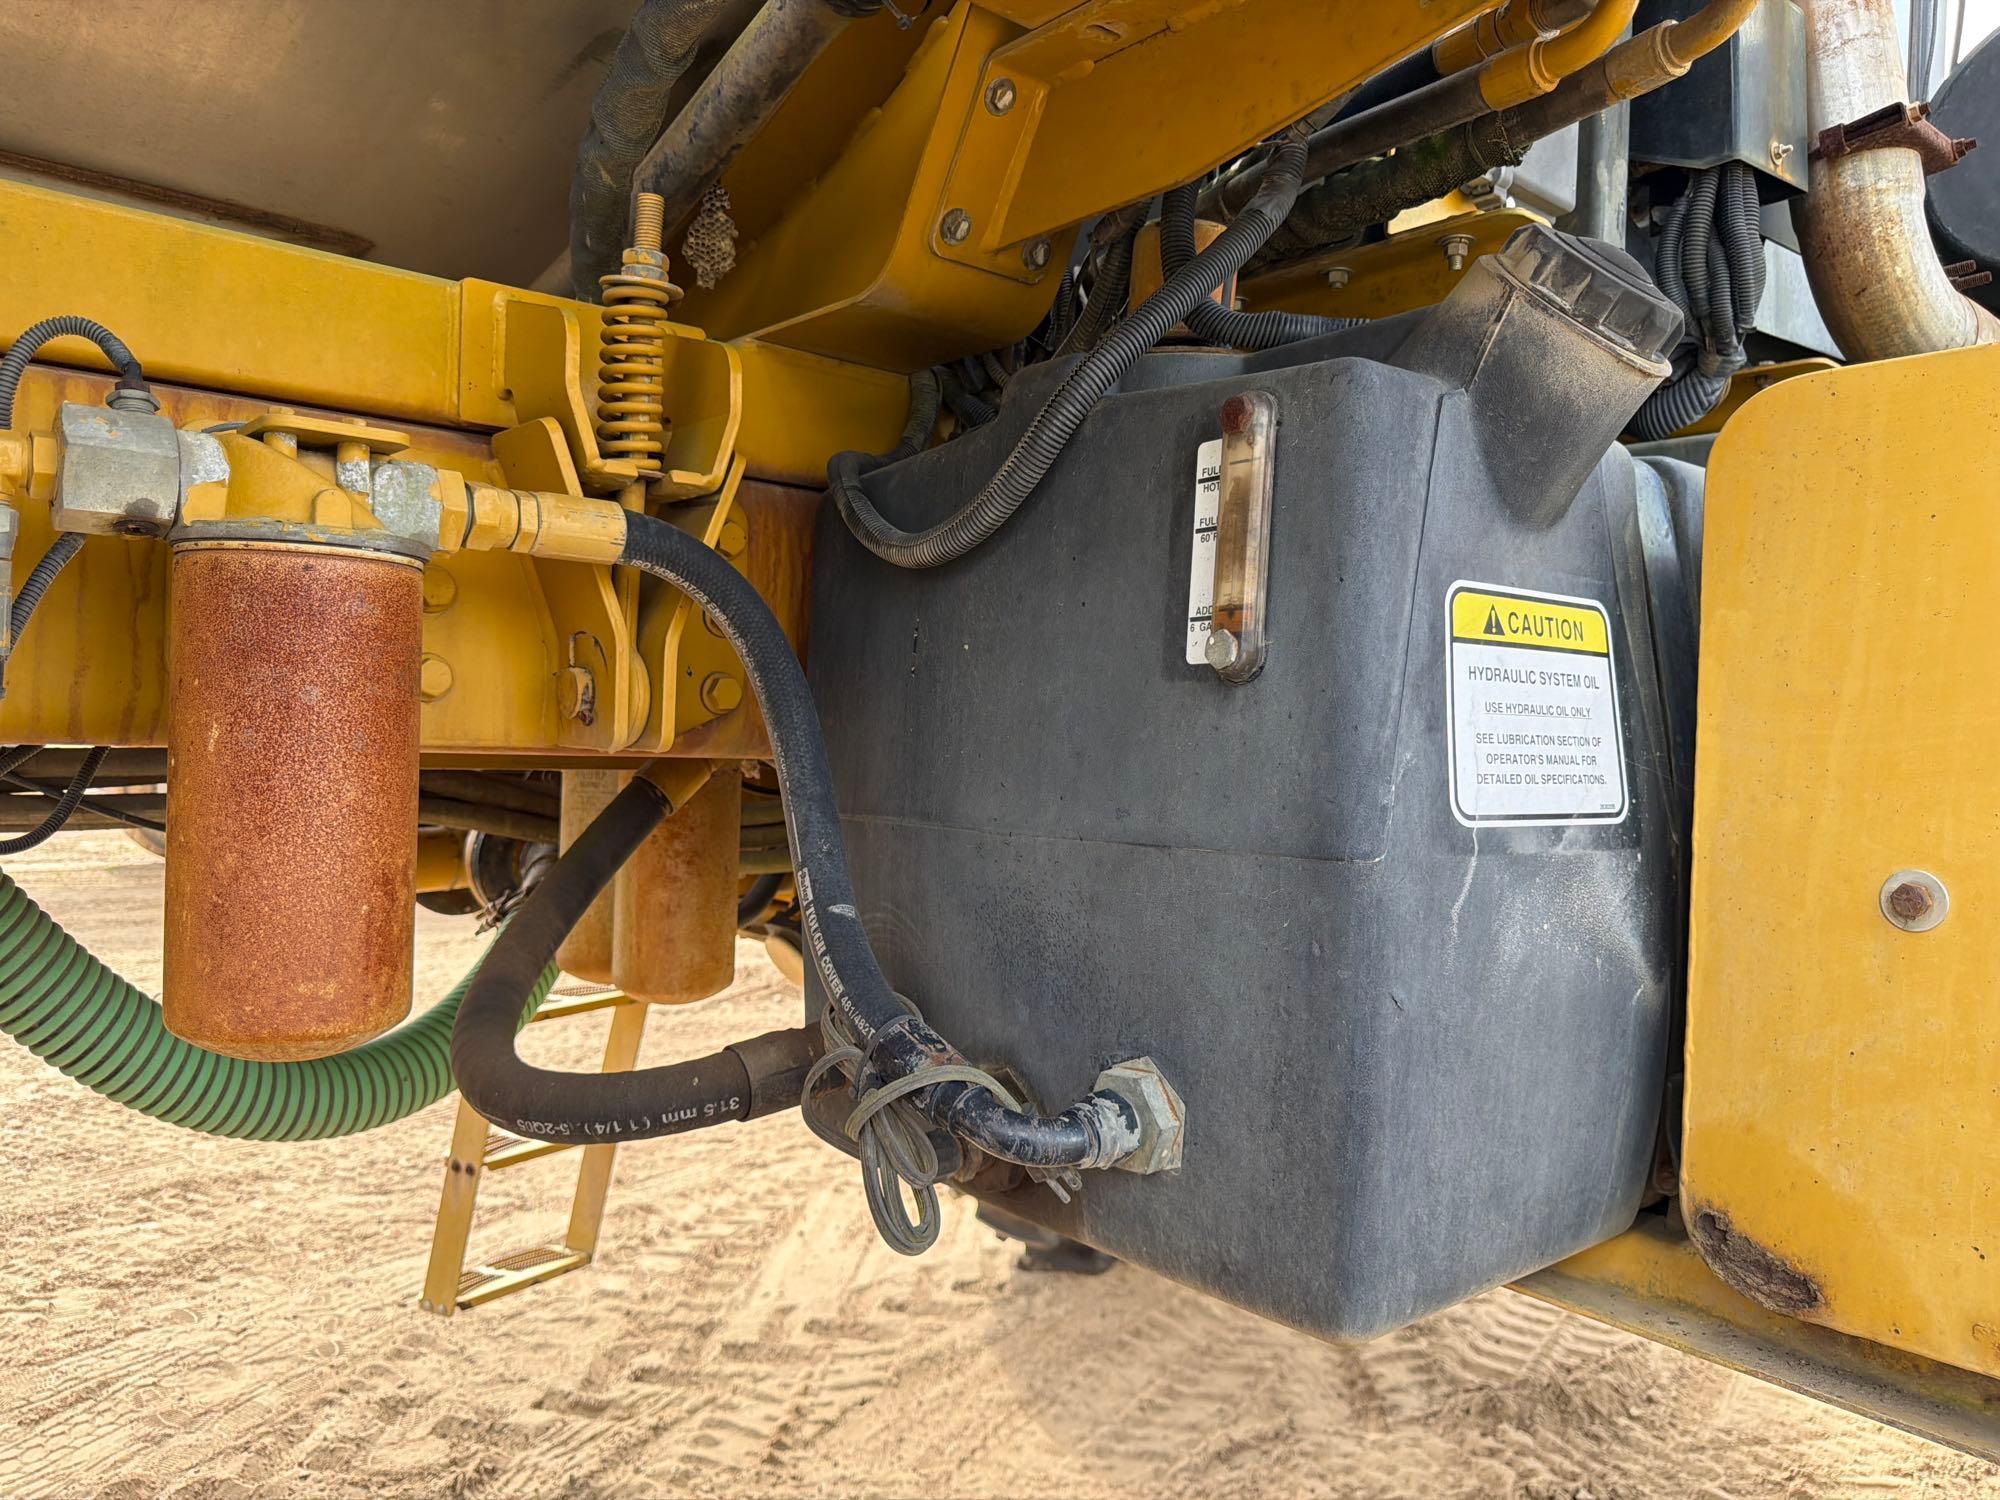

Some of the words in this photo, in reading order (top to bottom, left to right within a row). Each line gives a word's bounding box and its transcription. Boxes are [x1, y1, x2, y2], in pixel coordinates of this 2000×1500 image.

[1203, 482, 1220, 493] HOT
[1199, 517, 1217, 527] FUL
[630, 560, 652, 571] ISO
[1195, 605, 1213, 616] ADD
[1190, 623, 1195, 632] 6
[1199, 622, 1211, 632] GA
[1508, 611, 1584, 642] CAUTION
[1468, 666, 1536, 685] HYDRAULIC
[1539, 671, 1581, 688] SYSTEM
[1583, 675, 1600, 690] OIL
[1485, 701, 1503, 713] USE
[1505, 703, 1554, 716] HYDRAULIC
[1556, 705, 1569, 717] OIL
[1570, 706, 1591, 718] ONLY
[1475, 733, 1495, 744] SEE
[1497, 733, 1555, 746] LUBRICATION
[1557, 735, 1590, 747] SECTION
[1591, 736, 1602, 747] OF
[1486, 753, 1544, 765] OPERATOR'S
[1546, 754, 1580, 766] MANUAL
[1581, 755, 1597, 766] FOR
[1476, 773, 1522, 785] DETAILED
[1524, 773, 1539, 785] OIL
[1541, 774, 1607, 785] SPECIFICATIONS.
[804, 902, 827, 957] TOUGH
[821, 955, 846, 999] COVER
[661, 1108, 698, 1125] mm
